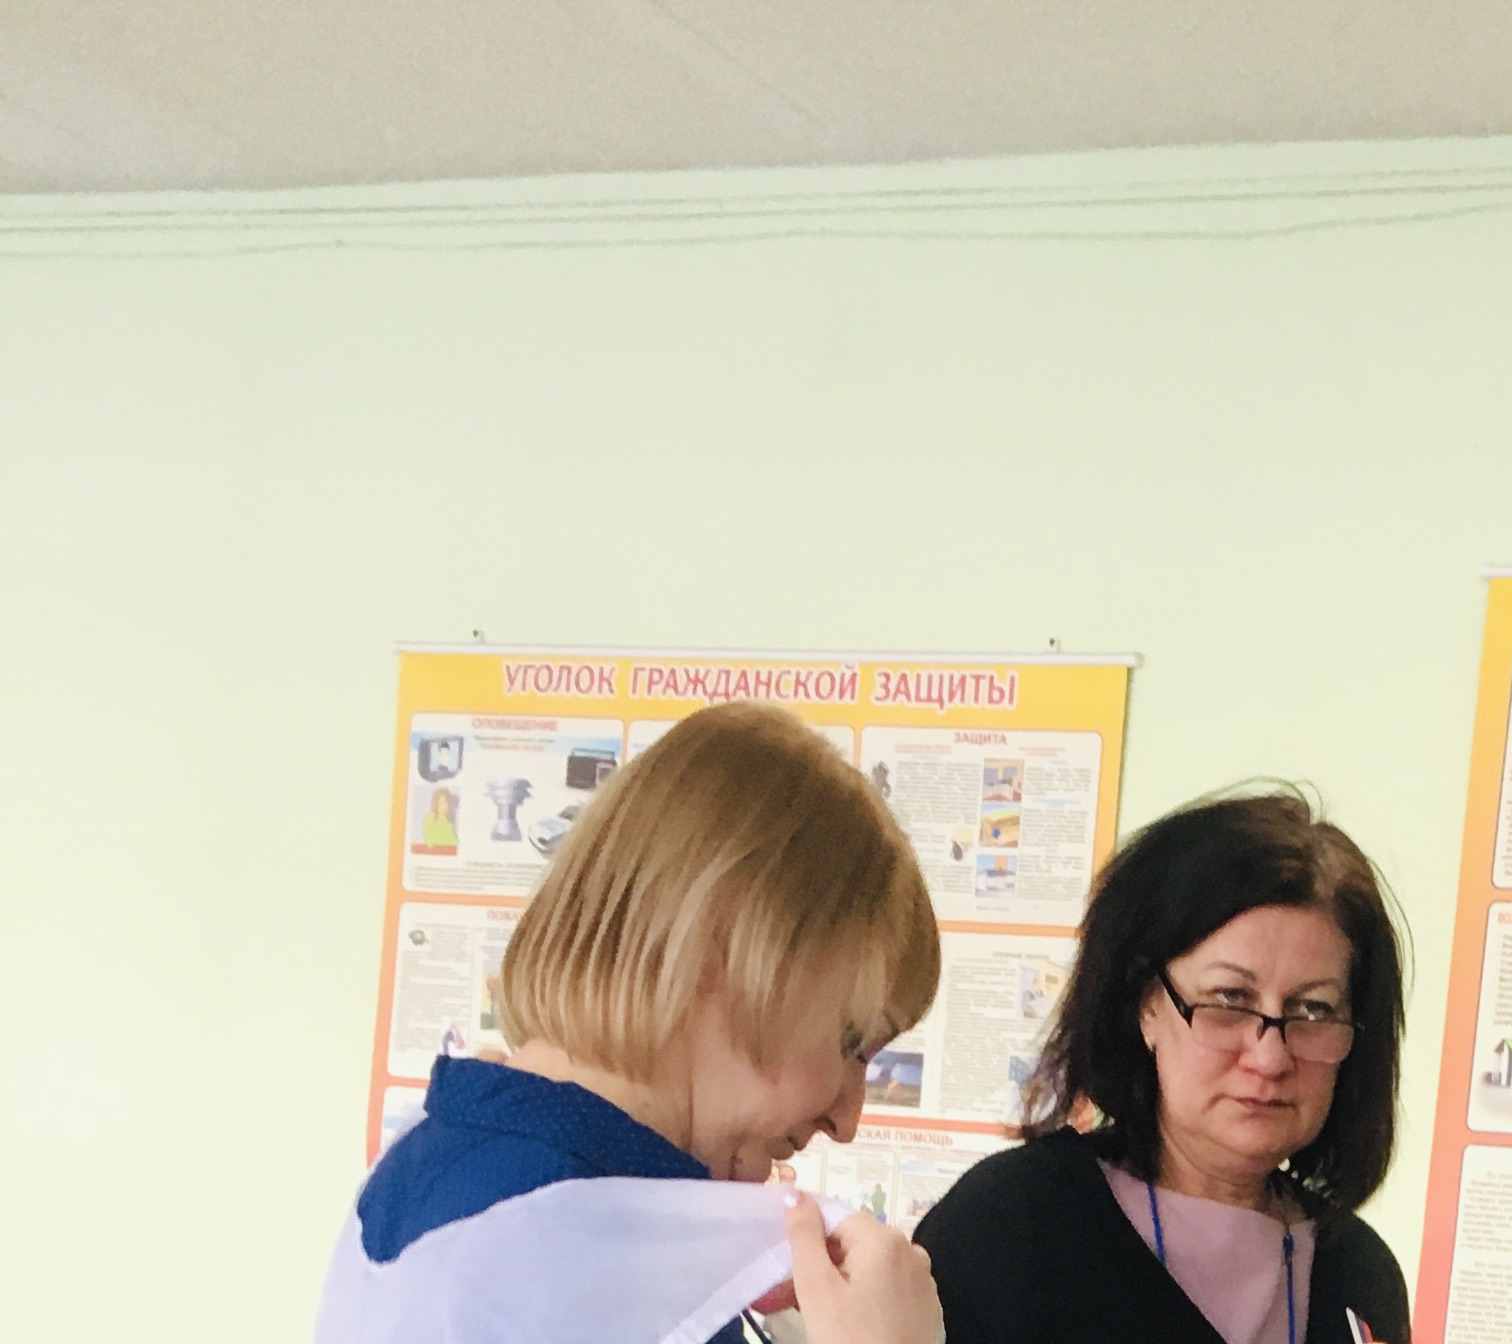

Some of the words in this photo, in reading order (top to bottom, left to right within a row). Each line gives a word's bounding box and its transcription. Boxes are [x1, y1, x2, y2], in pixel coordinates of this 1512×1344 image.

[505, 664, 616, 695] УГОЛОК
[631, 664, 858, 703] ГРАЖДАНСКОЙ
[875, 671, 1017, 710] ЗАЩИТЫ
[954, 732, 1008, 746] ЗАЩИТА
[857, 1128, 891, 1142] СКАЯ
[894, 1130, 954, 1147] ПОМОЩЬ
